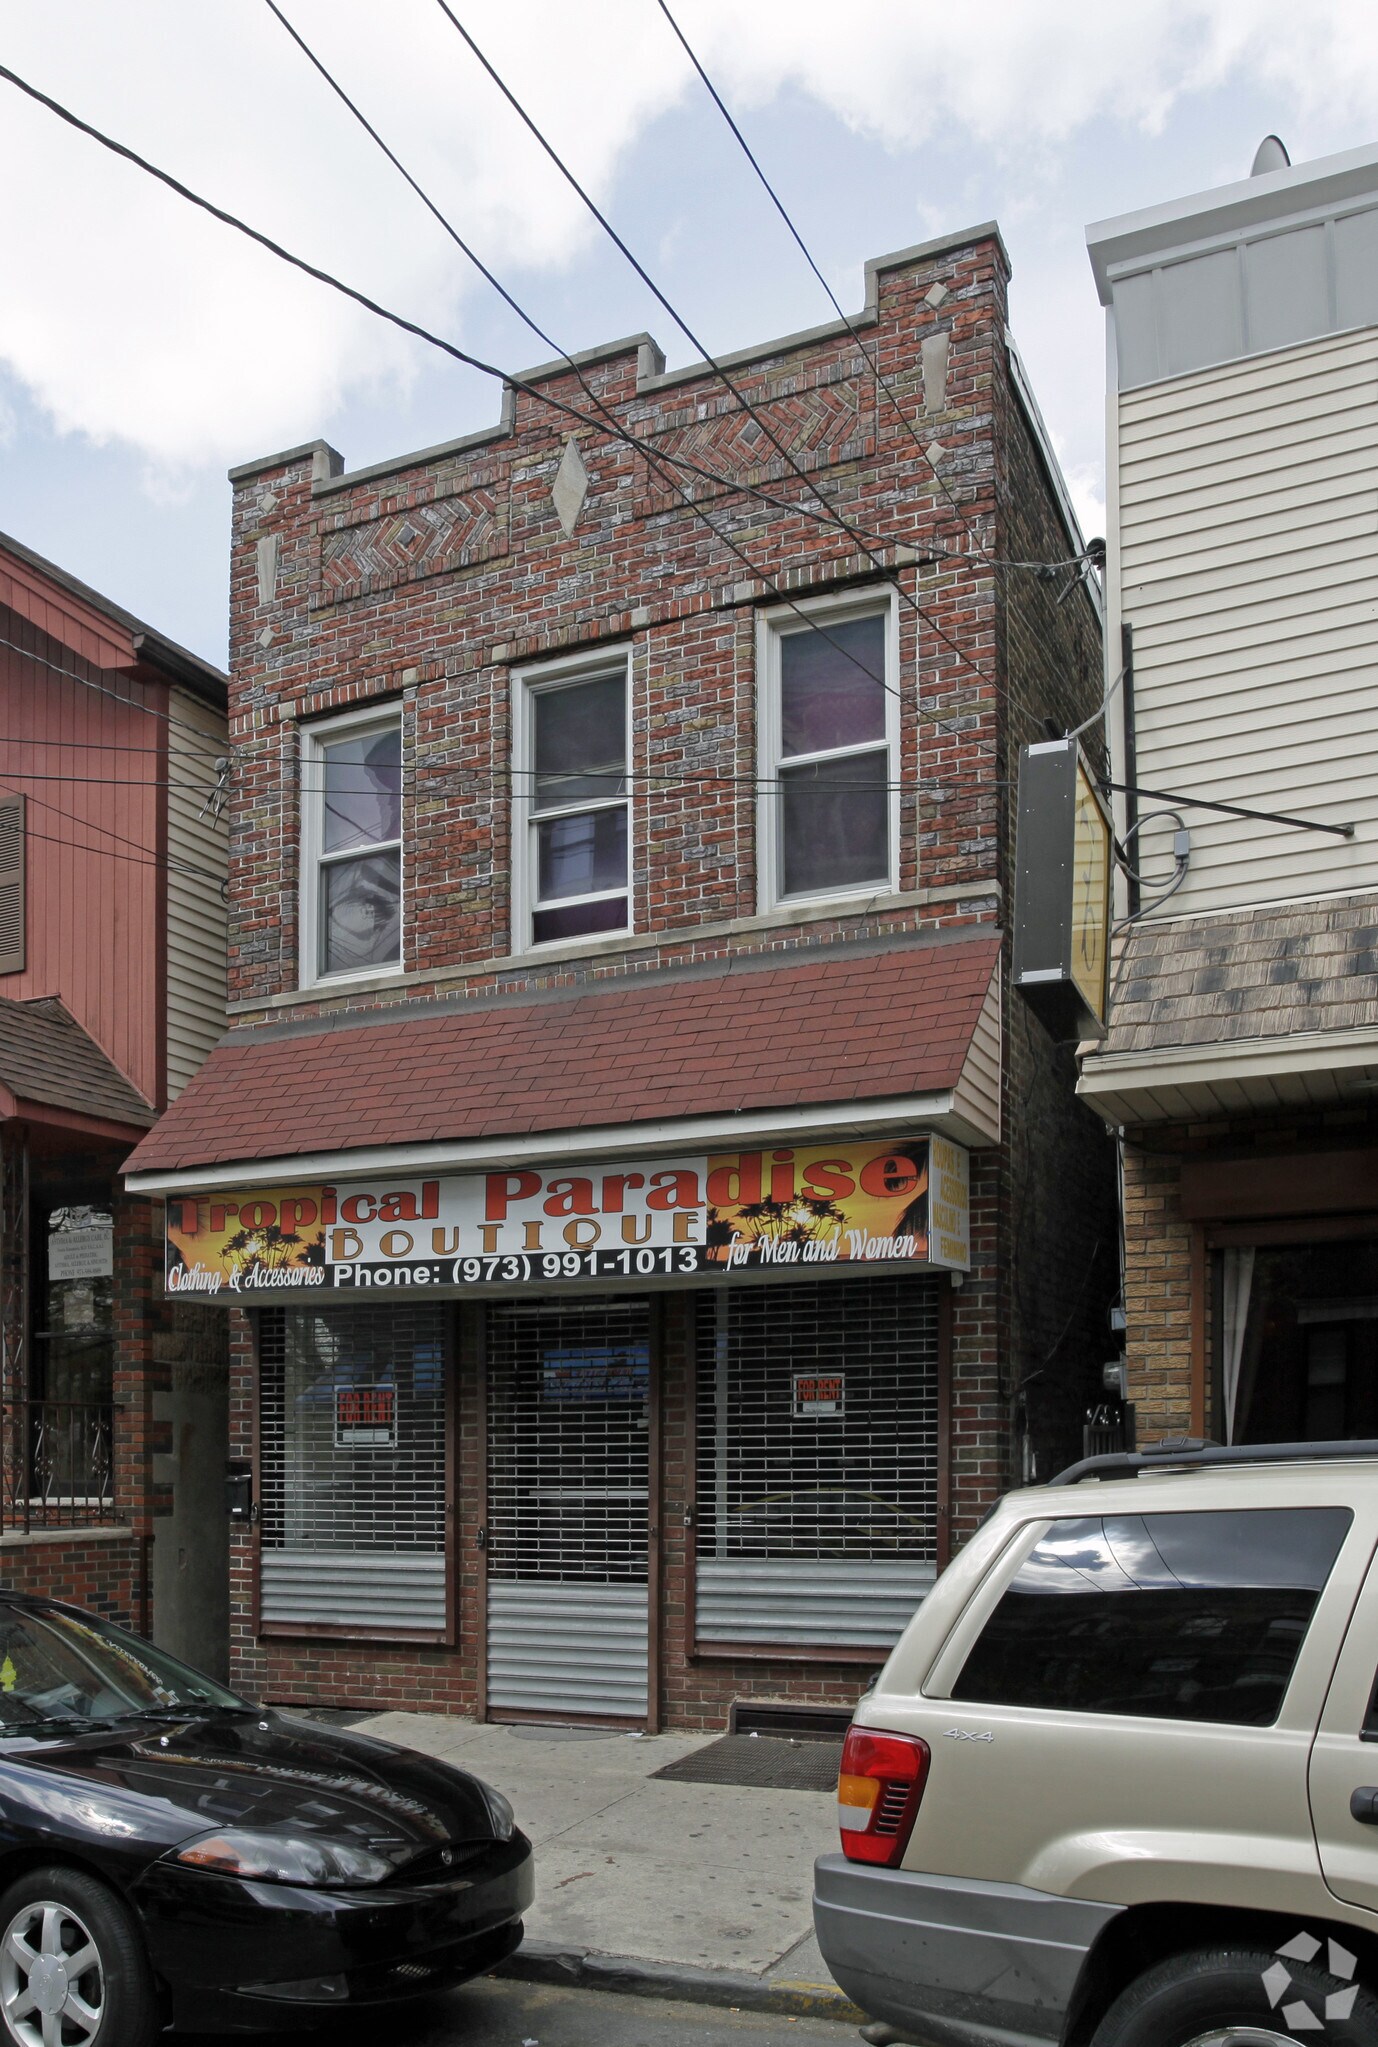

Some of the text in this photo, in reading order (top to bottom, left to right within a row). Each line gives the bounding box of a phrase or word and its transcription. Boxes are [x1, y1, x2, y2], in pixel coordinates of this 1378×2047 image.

[172, 1149, 919, 1235] Tropical Paradise
[329, 1211, 699, 1261] BOUTIQUE
[722, 1226, 918, 1272] for Men and Women
[168, 1257, 326, 1295] Clothing & Accessories
[333, 1247, 699, 1288] Phone: (973) 991-1013
[338, 1391, 394, 1425] FOR RENT
[797, 1378, 842, 1402] FOR RENT
